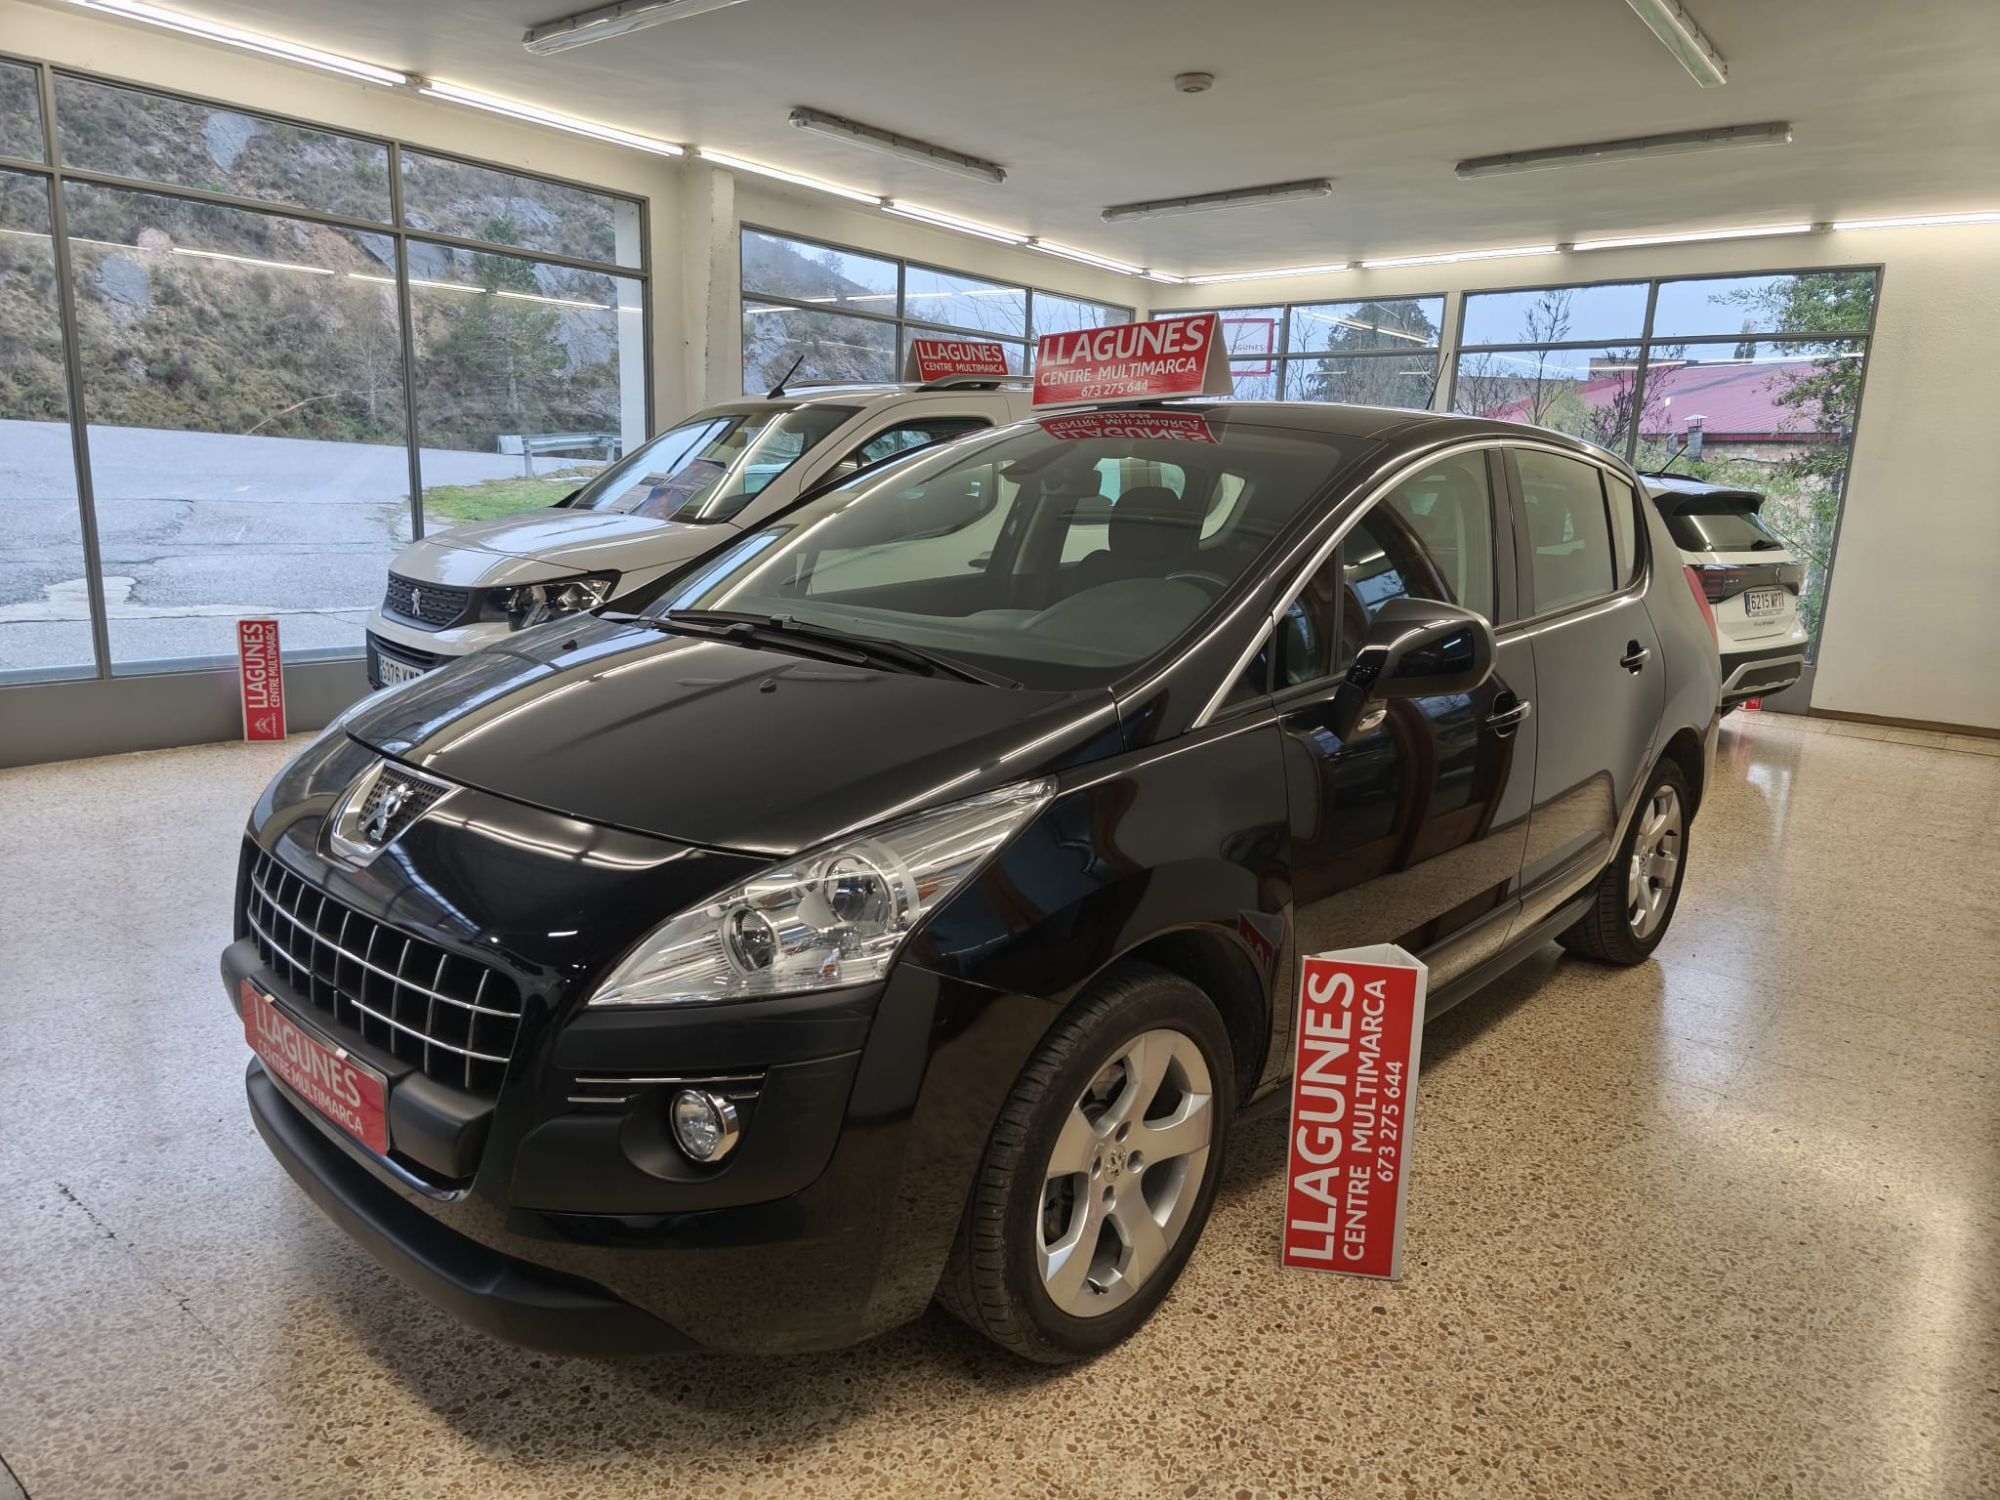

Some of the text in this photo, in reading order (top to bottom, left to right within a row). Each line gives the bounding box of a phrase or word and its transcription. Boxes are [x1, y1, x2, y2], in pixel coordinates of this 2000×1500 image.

[917, 341, 1003, 363] LLAGUNES
[923, 361, 1006, 373] CENTRE MULTIMARCA
[1041, 356, 1197, 387] CENTRE MULTIMARCA
[1042, 318, 1207, 367] LLAGUNES
[1081, 379, 1149, 398] 673 275 644
[1751, 593, 1770, 610] 6215
[242, 623, 269, 709] LLAGUNES
[265, 623, 281, 708] CENTRE MULTIMARCA
[254, 997, 361, 1108] LLAGUNES
[258, 1038, 364, 1136] CENTRE MULTIMARCA
[1289, 972, 1355, 1261] LLAGUNES
[1343, 978, 1387, 1262] CENTRE MULTIMARCA
[1377, 1061, 1403, 1183] 673 275 644
